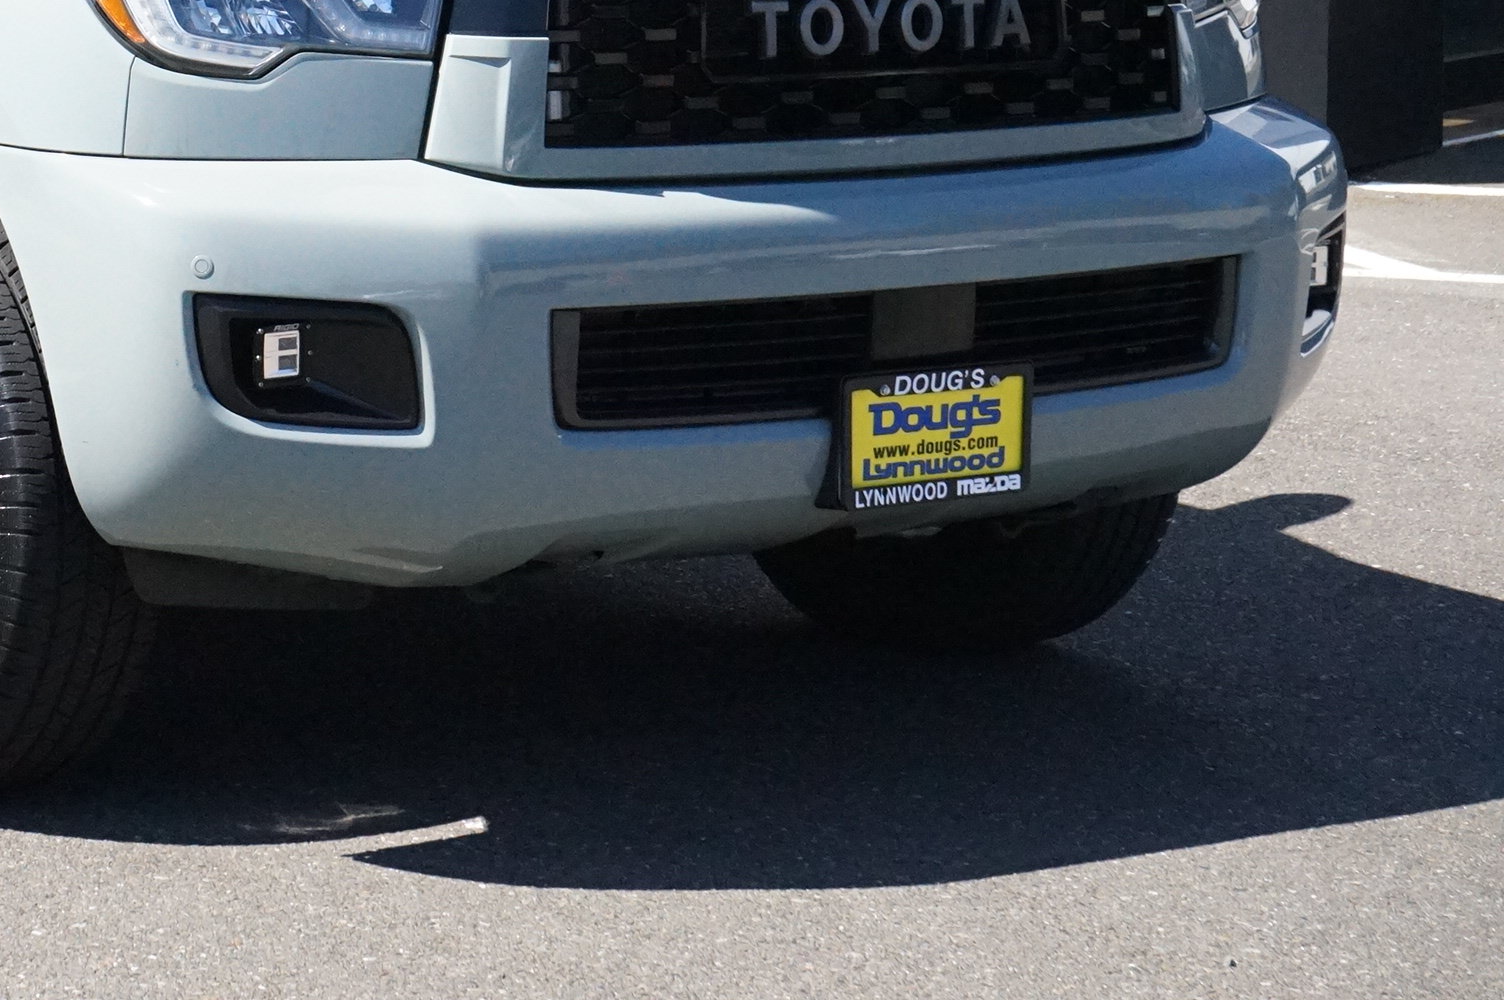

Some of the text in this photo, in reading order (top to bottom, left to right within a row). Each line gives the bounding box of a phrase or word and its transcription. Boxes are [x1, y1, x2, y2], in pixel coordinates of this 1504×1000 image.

[894, 368, 985, 396] DOUG'S
[868, 394, 1001, 439] Doug's
[873, 435, 998, 459] www.dougs.com
[862, 446, 1006, 482] Lynnwood
[855, 481, 948, 509] LYNNWOOD
